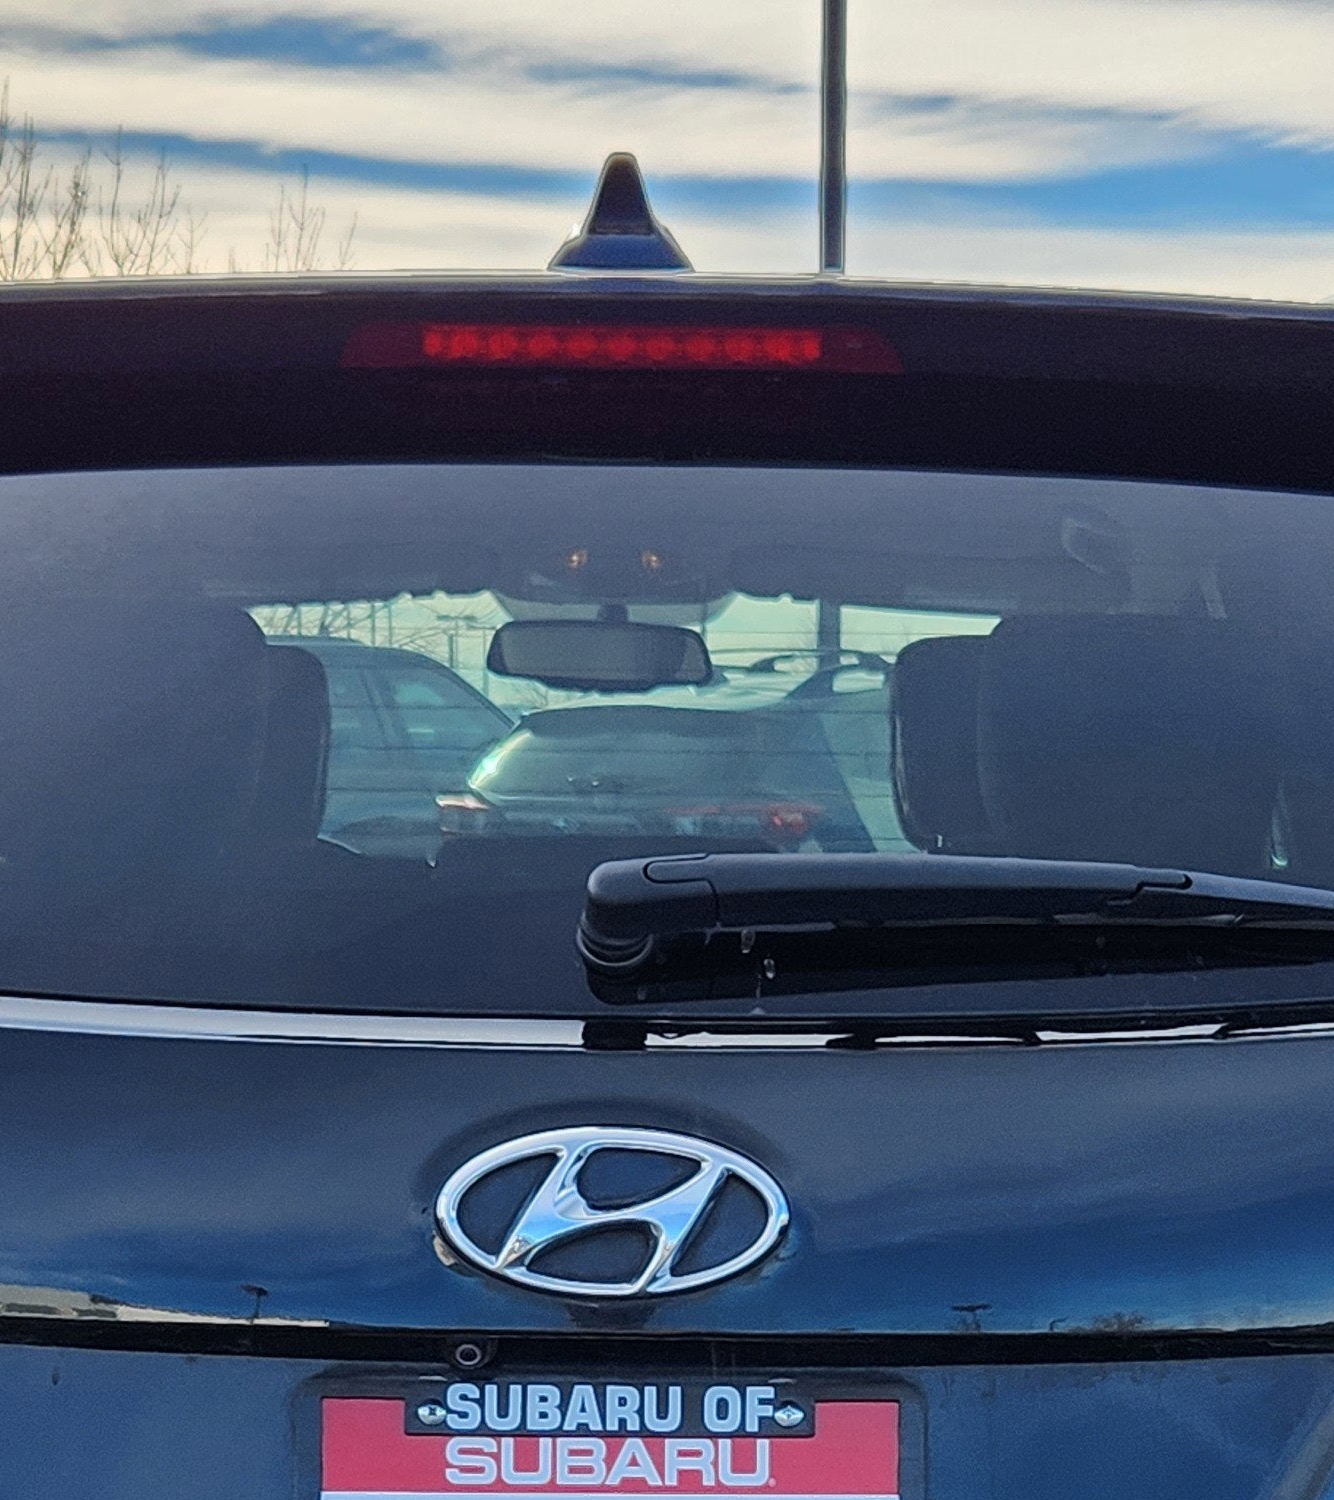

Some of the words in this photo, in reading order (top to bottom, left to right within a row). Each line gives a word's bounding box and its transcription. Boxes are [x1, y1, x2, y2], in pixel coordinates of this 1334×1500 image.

[446, 1382, 682, 1432] SUBARU
[703, 1385, 776, 1433] OF
[445, 1437, 770, 1487] SUBARU
